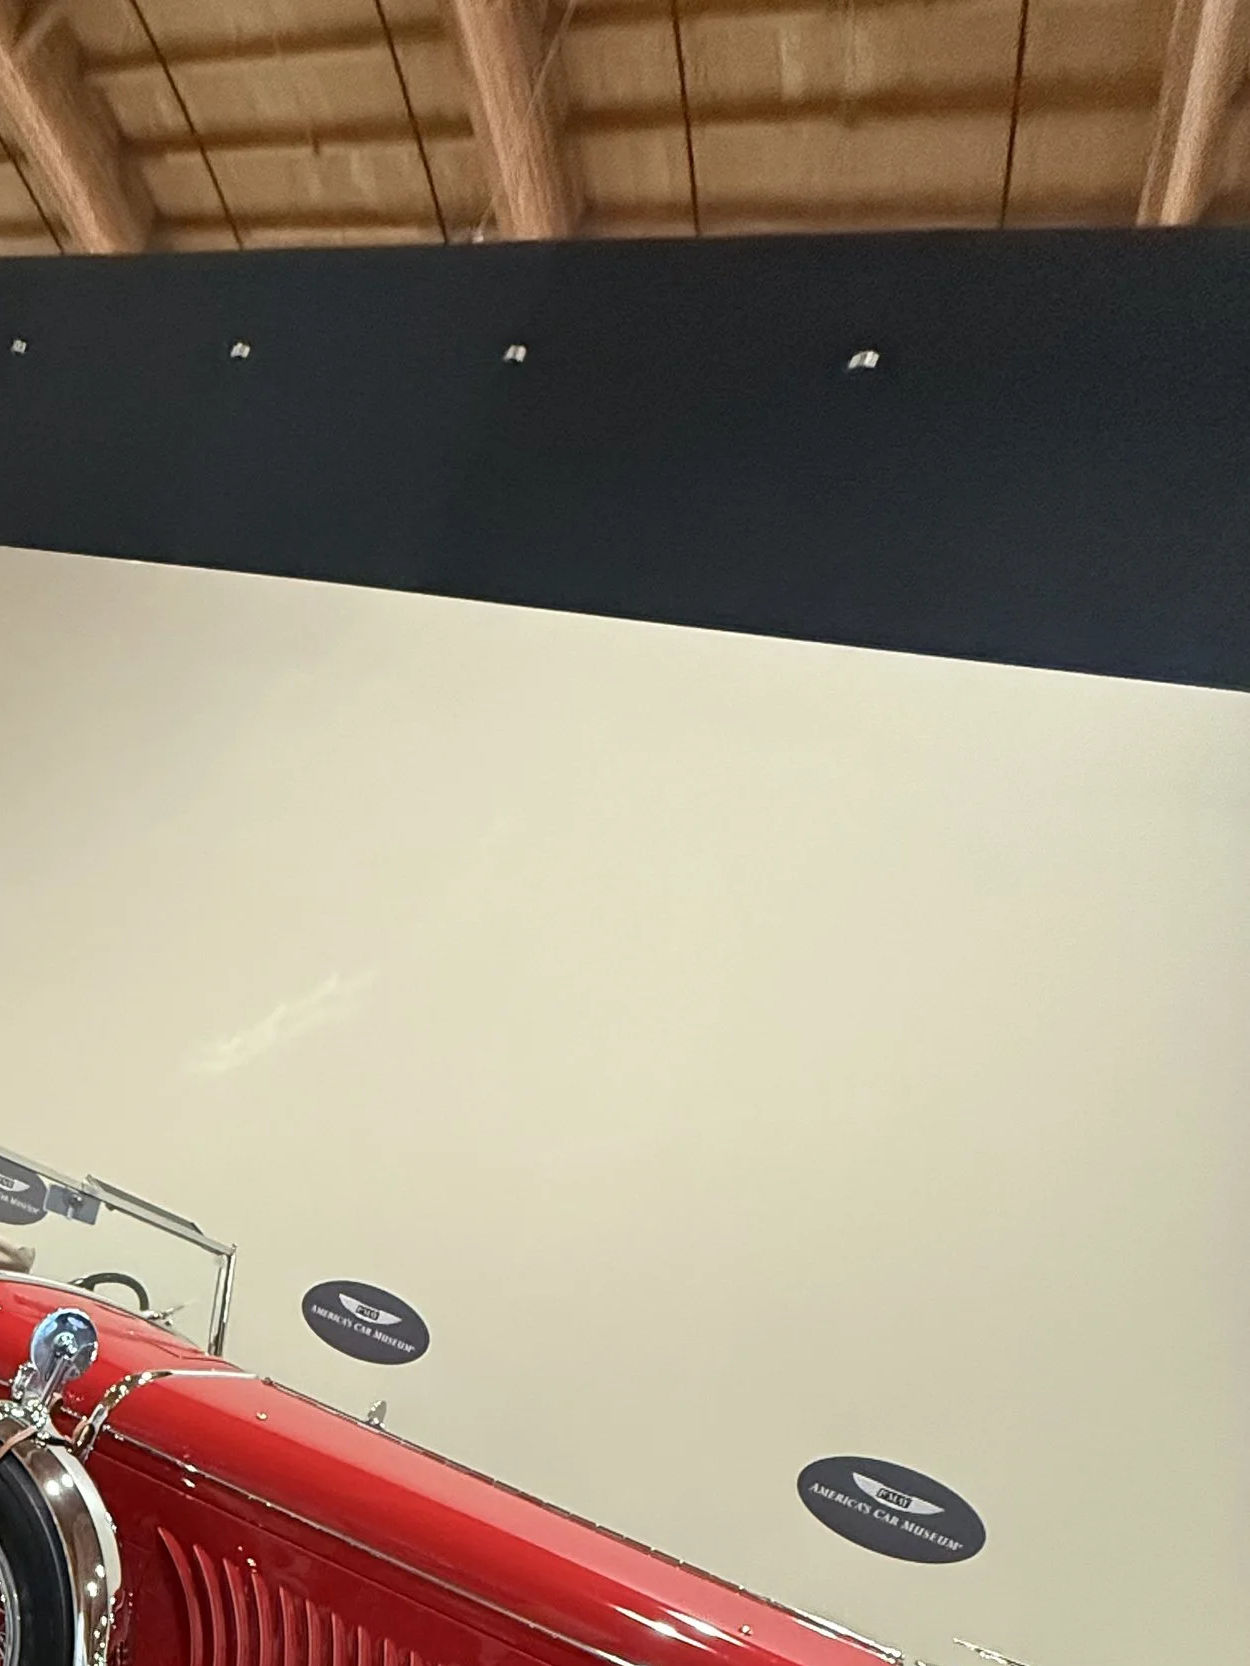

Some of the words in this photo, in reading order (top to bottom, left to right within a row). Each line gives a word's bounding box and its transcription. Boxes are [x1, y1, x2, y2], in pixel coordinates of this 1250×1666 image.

[353, 1323, 373, 1337] CAR
[808, 1482, 872, 1515] AMERICA'S
[873, 1508, 901, 1527] CAR
[900, 1519, 961, 1551] MUSEUM
